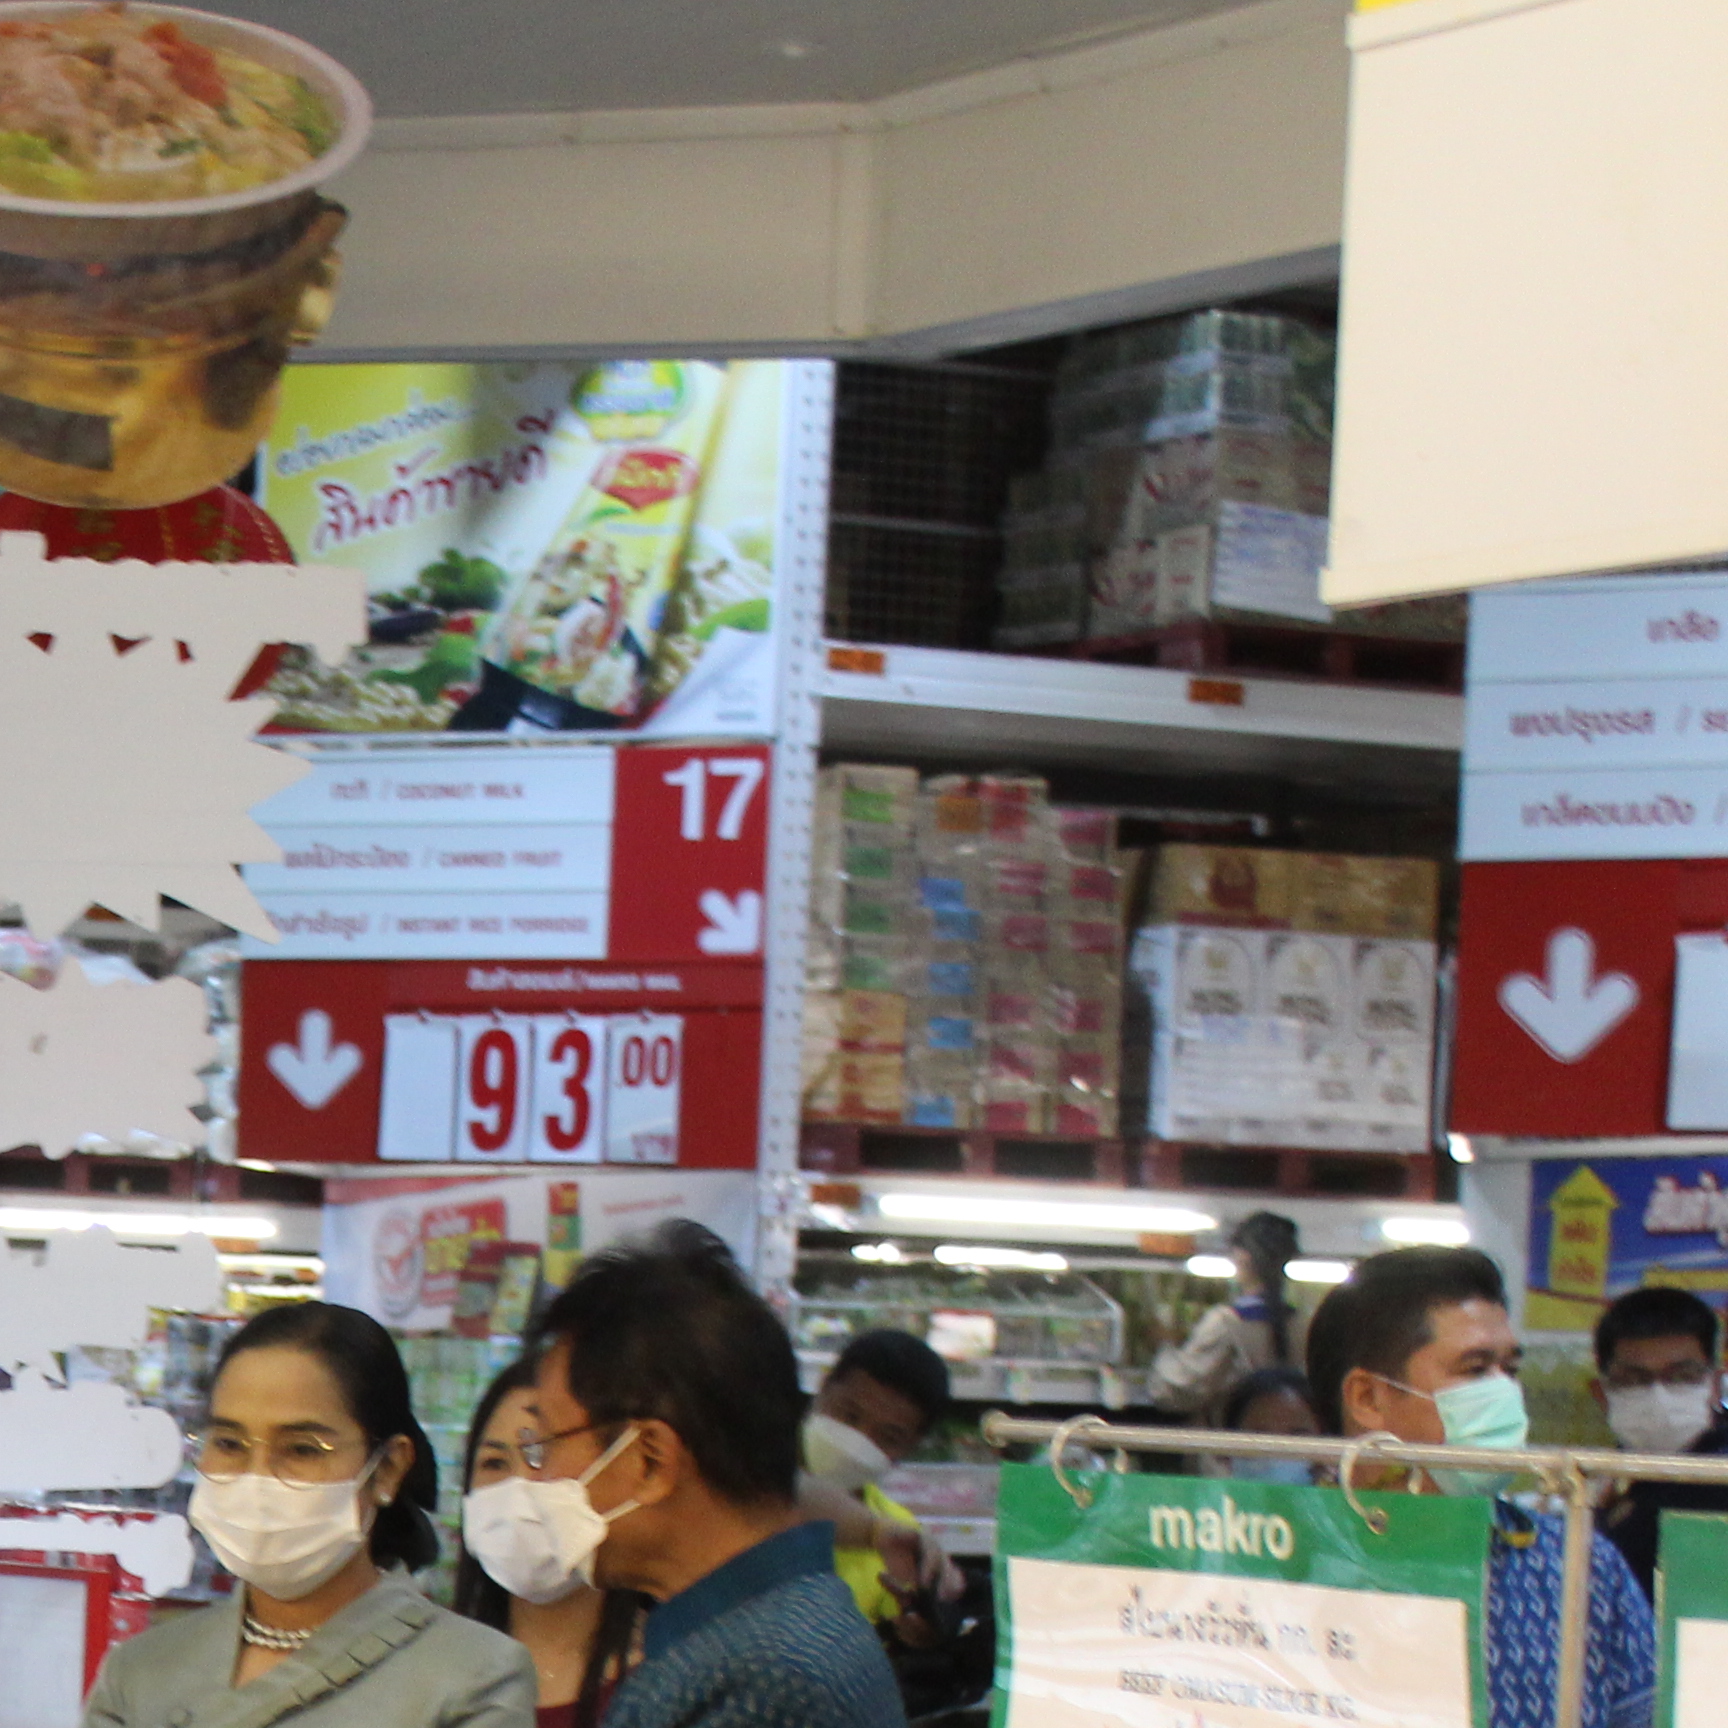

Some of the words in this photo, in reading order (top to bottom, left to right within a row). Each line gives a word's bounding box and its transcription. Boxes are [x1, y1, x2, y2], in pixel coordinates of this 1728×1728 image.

[662, 757, 764, 842] 17
[468, 1028, 592, 1151] 93
[1149, 1495, 1294, 1560] makro
